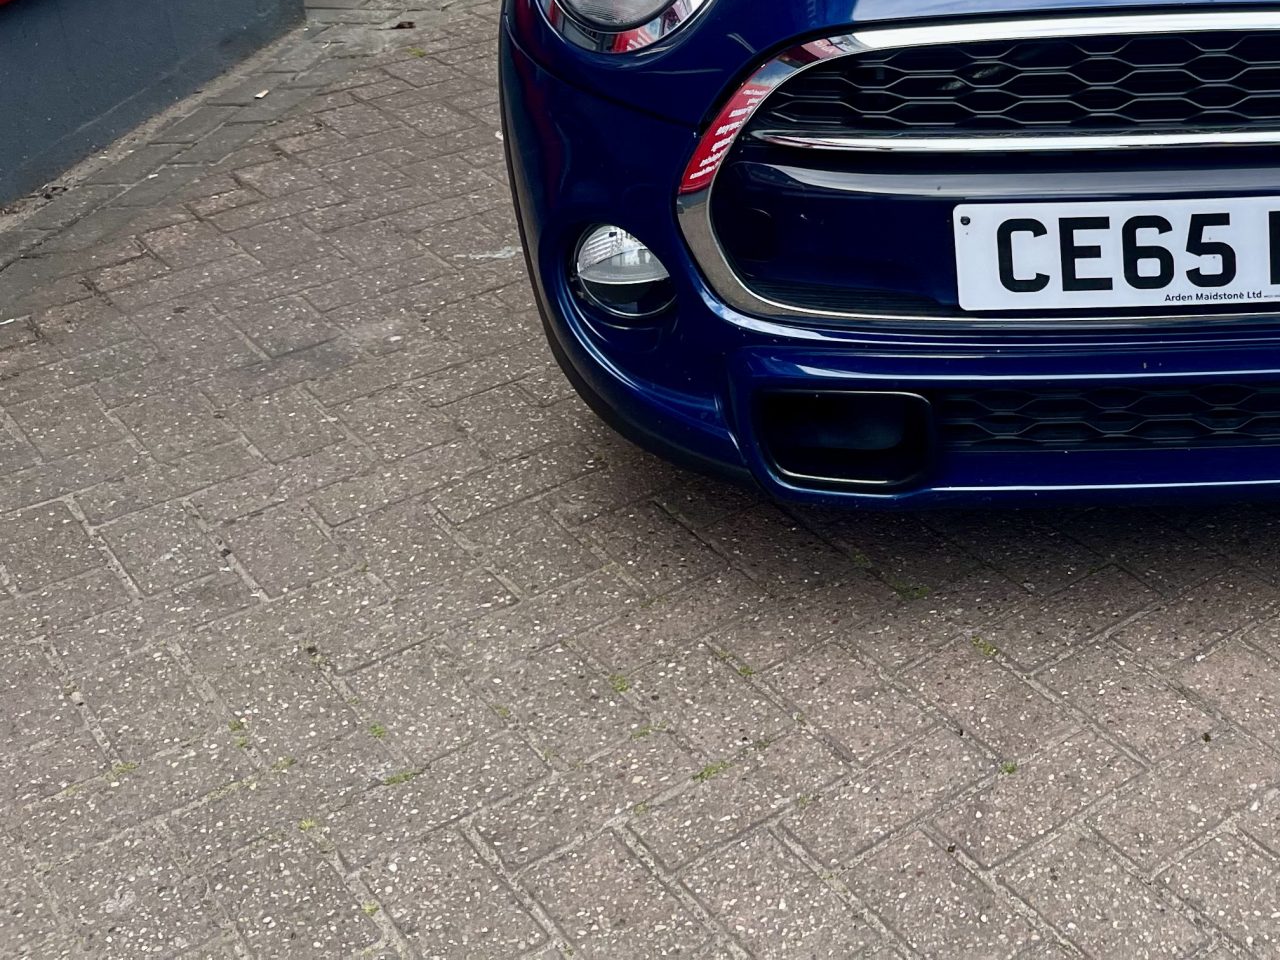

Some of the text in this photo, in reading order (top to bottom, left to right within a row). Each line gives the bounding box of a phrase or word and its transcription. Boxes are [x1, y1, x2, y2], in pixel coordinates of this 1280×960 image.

[996, 214, 1238, 292] CE65
[1164, 293, 1193, 302] Arden
[1195, 291, 1245, 301] Maidstone
[1247, 290, 1262, 299] Ltd
